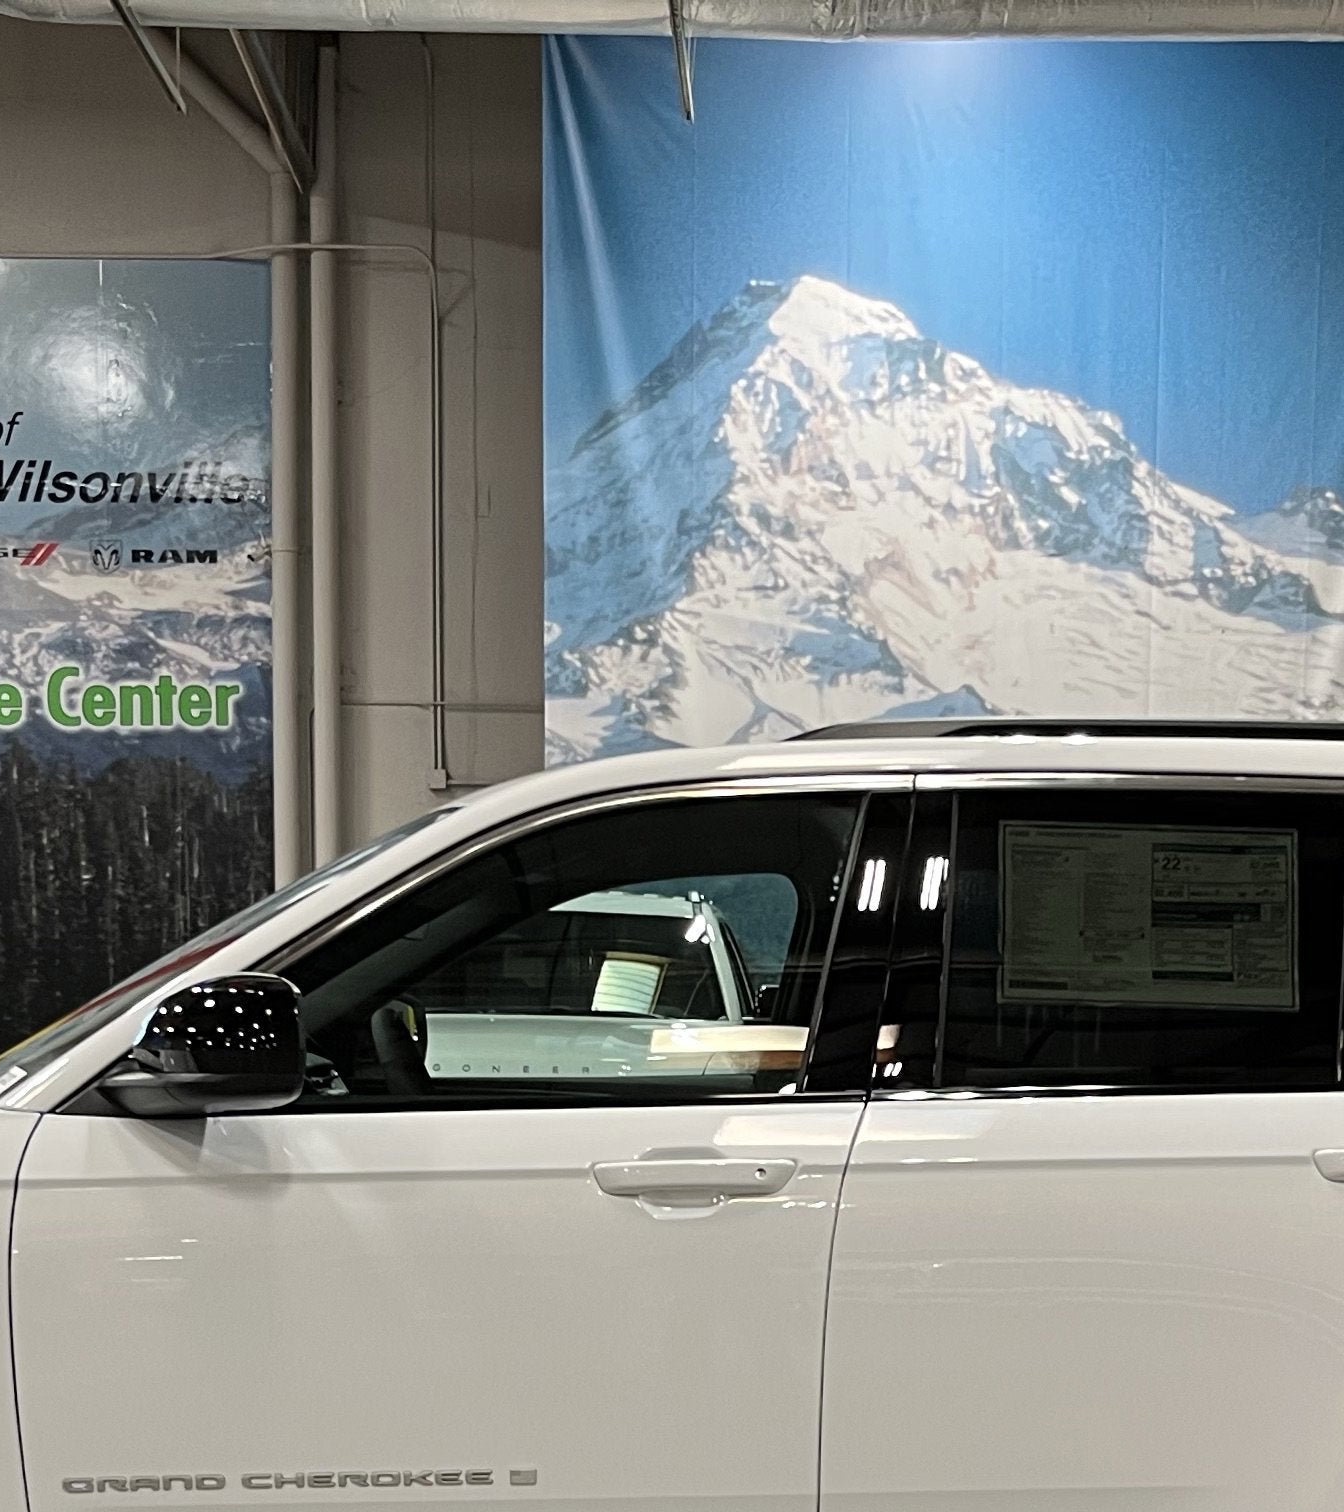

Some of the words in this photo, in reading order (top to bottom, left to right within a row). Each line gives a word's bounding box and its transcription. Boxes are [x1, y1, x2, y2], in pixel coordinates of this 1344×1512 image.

[131, 548, 219, 564] RAM
[47, 667, 240, 728] Center
[62, 1475, 227, 1493] GRAND
[241, 1469, 495, 1490] CHEROKEE
